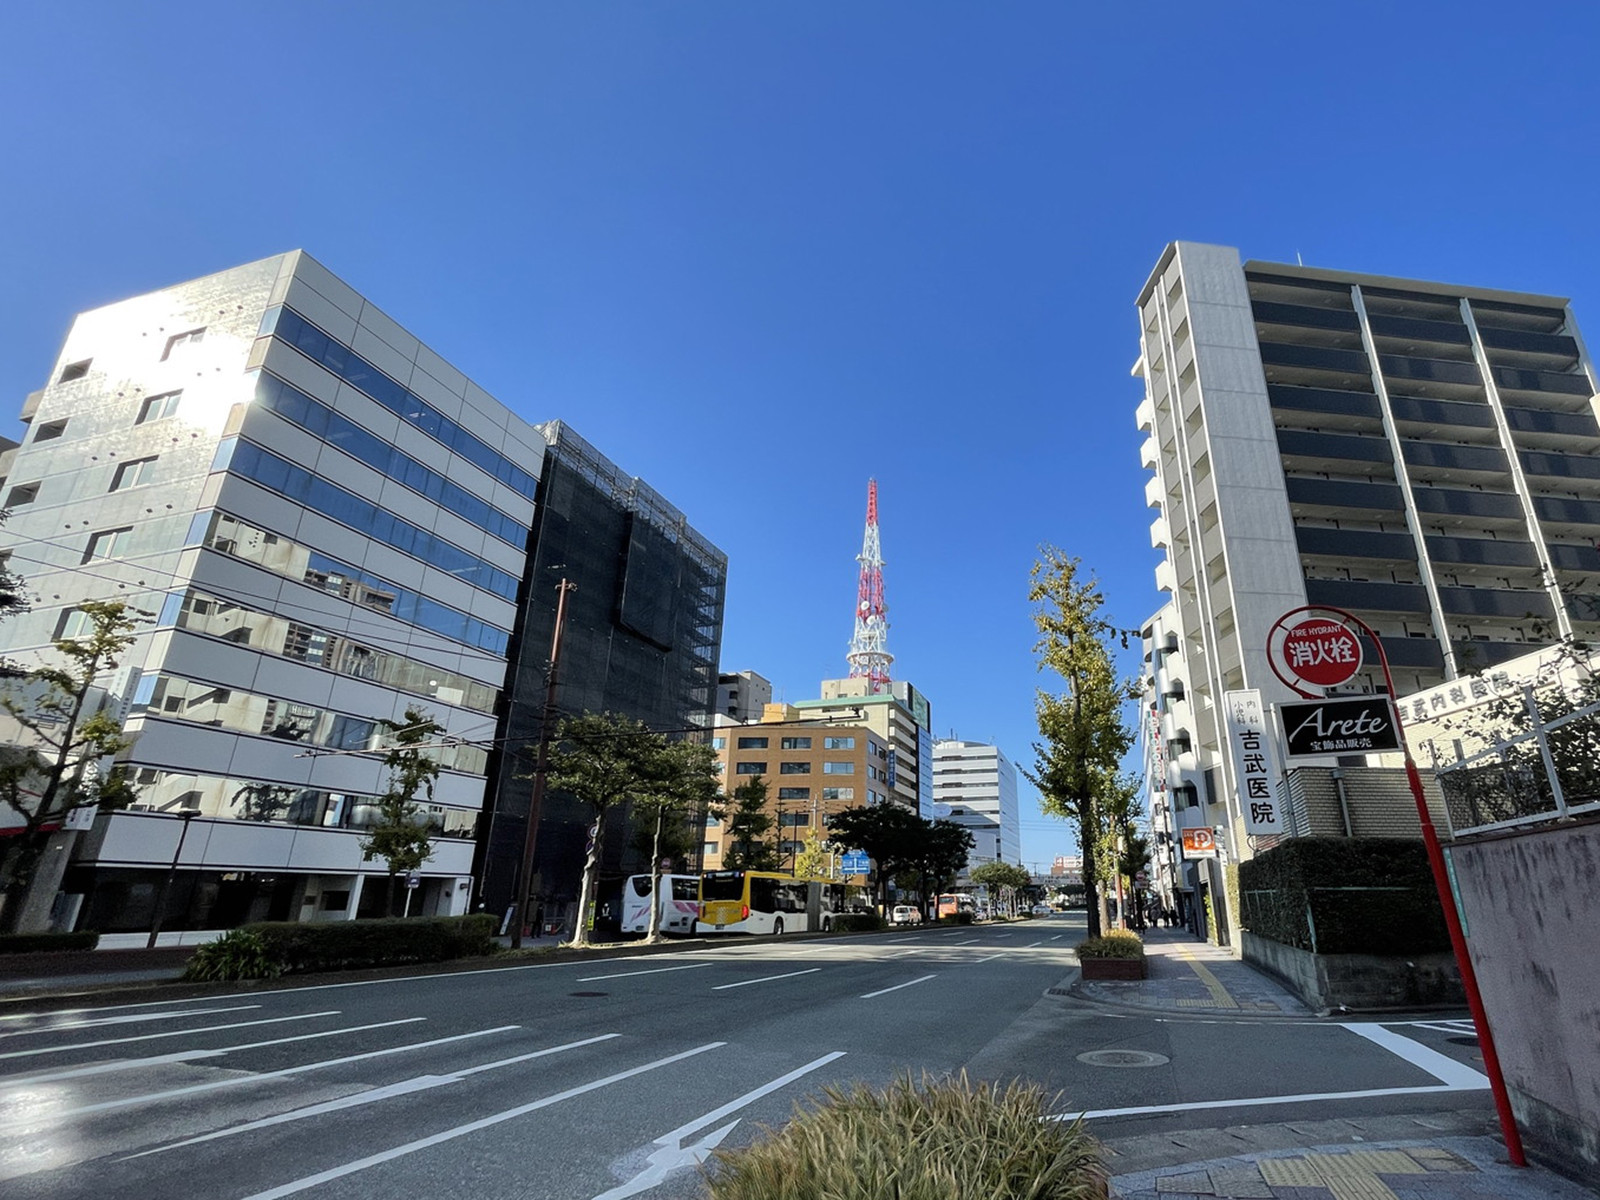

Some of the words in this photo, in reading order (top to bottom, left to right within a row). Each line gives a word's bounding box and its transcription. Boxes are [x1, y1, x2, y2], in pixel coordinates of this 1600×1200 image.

[1291, 628, 1307, 638] FIRE
[1309, 624, 1342, 636] HYDRANT
[1287, 636, 1357, 667] 消火栓
[1234, 700, 1246, 726] 小児科
[1246, 699, 1259, 725] 内科
[1289, 707, 1388, 744] Arete
[1310, 737, 1373, 752] 宝飾品販売
[1239, 729, 1275, 824] 吉武医院
